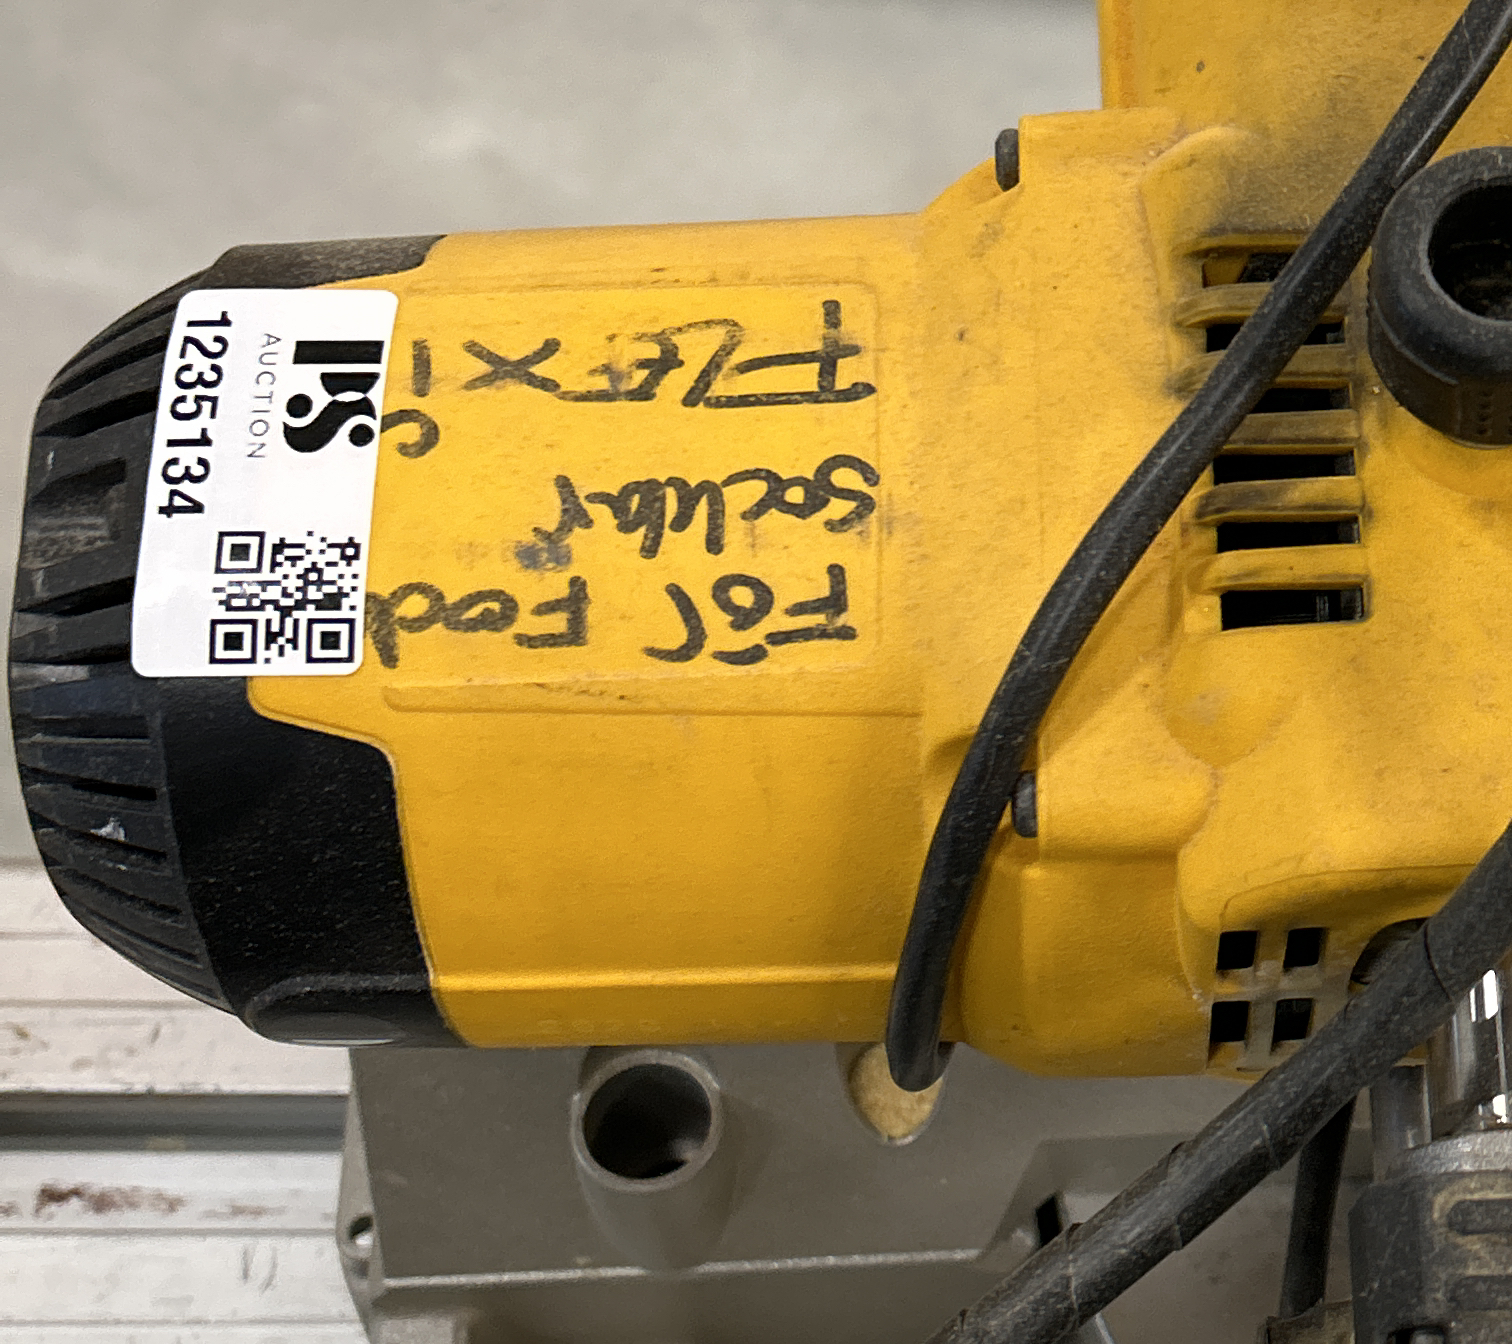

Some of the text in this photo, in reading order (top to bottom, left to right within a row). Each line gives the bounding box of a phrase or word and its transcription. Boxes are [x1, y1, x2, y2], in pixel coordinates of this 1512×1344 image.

[158, 310, 233, 518] 1235134
[246, 332, 282, 458] AUCTION
[642, 563, 858, 666] För
